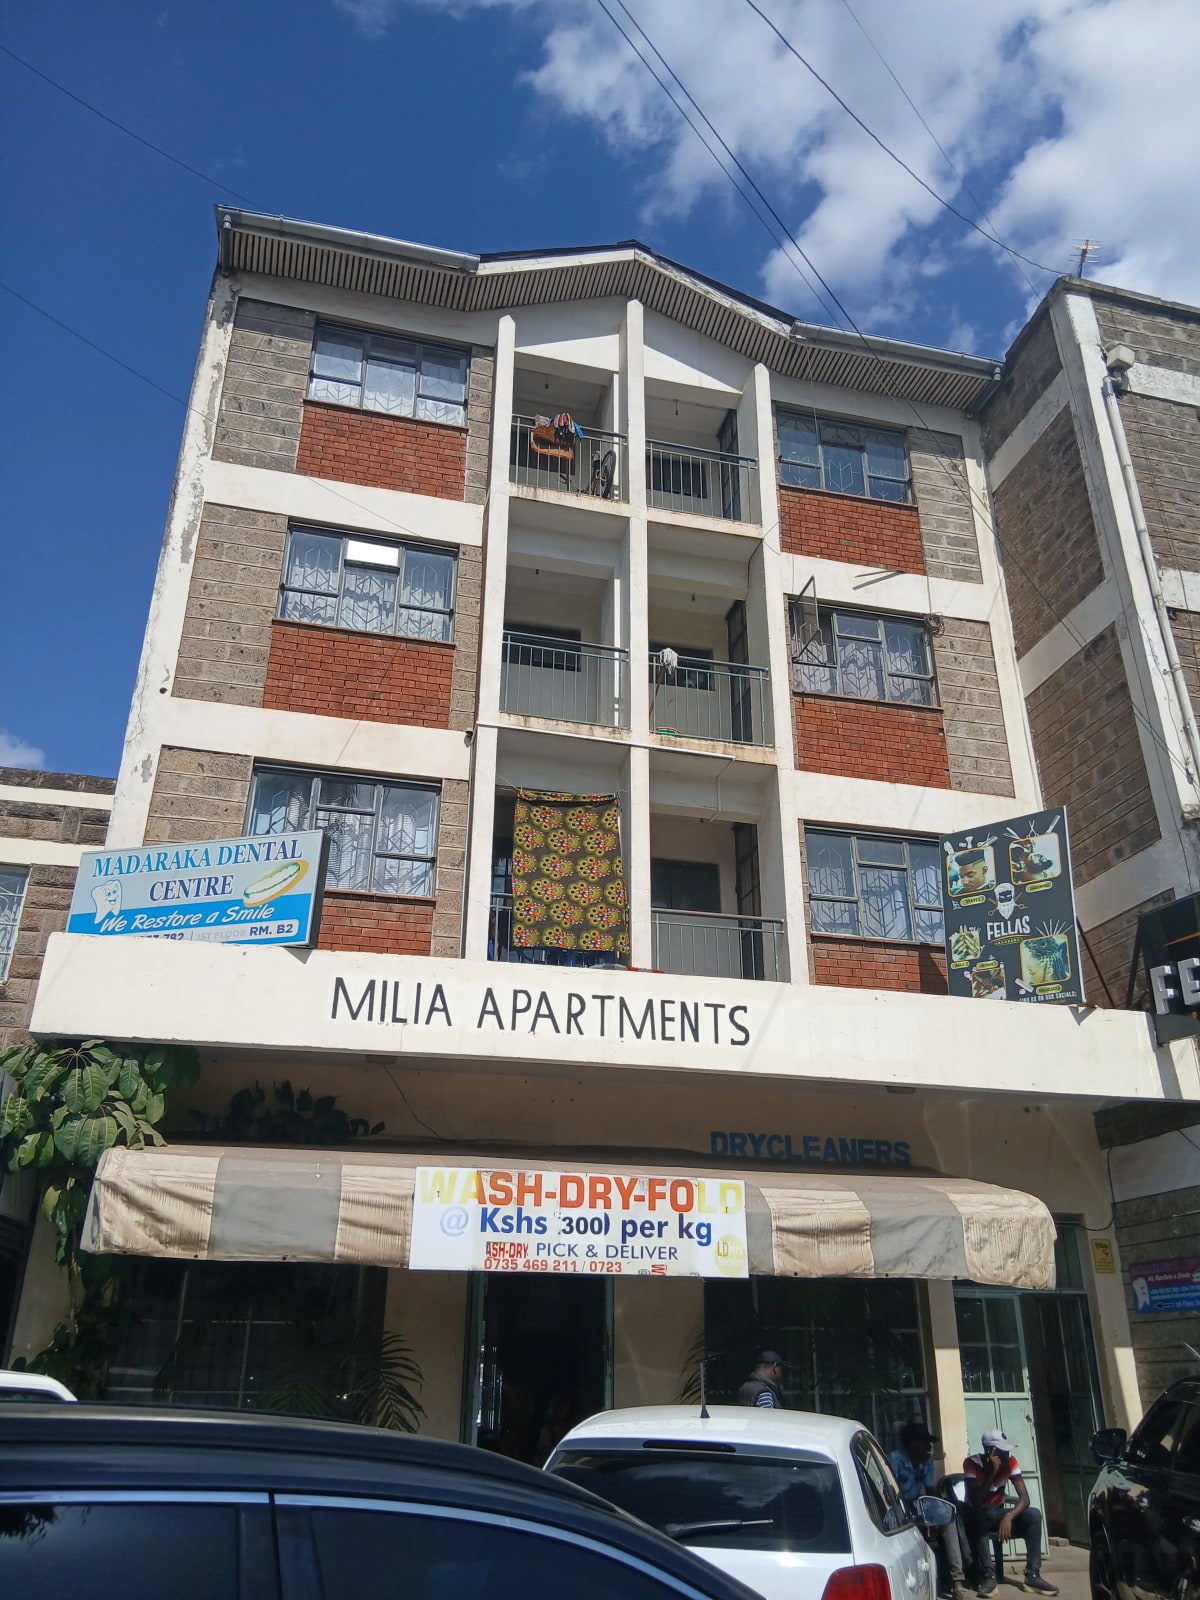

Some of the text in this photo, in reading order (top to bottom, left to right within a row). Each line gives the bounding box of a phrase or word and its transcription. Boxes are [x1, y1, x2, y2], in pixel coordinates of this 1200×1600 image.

[91, 839, 303, 878] MADARAKA DENTAL
[149, 874, 234, 901] CENTRE
[100, 905, 275, 933] We Restore a Smile
[249, 925, 272, 936] RM.
[276, 923, 293, 934] B2
[986, 915, 1031, 940] FELLAS
[331, 976, 751, 1047] MILIA APARTMENTS
[709, 1131, 911, 1166] DRYCLEANERS
[419, 1170, 744, 1215] WASH-DRY-FOLD
[440, 1206, 469, 1237] @
[480, 1207, 548, 1234] Kshs
[621, 1217, 669, 1244] per
[678, 1213, 712, 1246] kg
[536, 1242, 579, 1258] PICK
[585, 1244, 598, 1258] &
[605, 1245, 679, 1260] DELIVER
[484, 1258, 518, 1270] 0735
[522, 1258, 548, 1271] 469
[552, 1260, 577, 1272] 211
[589, 1261, 622, 1273] 0723
